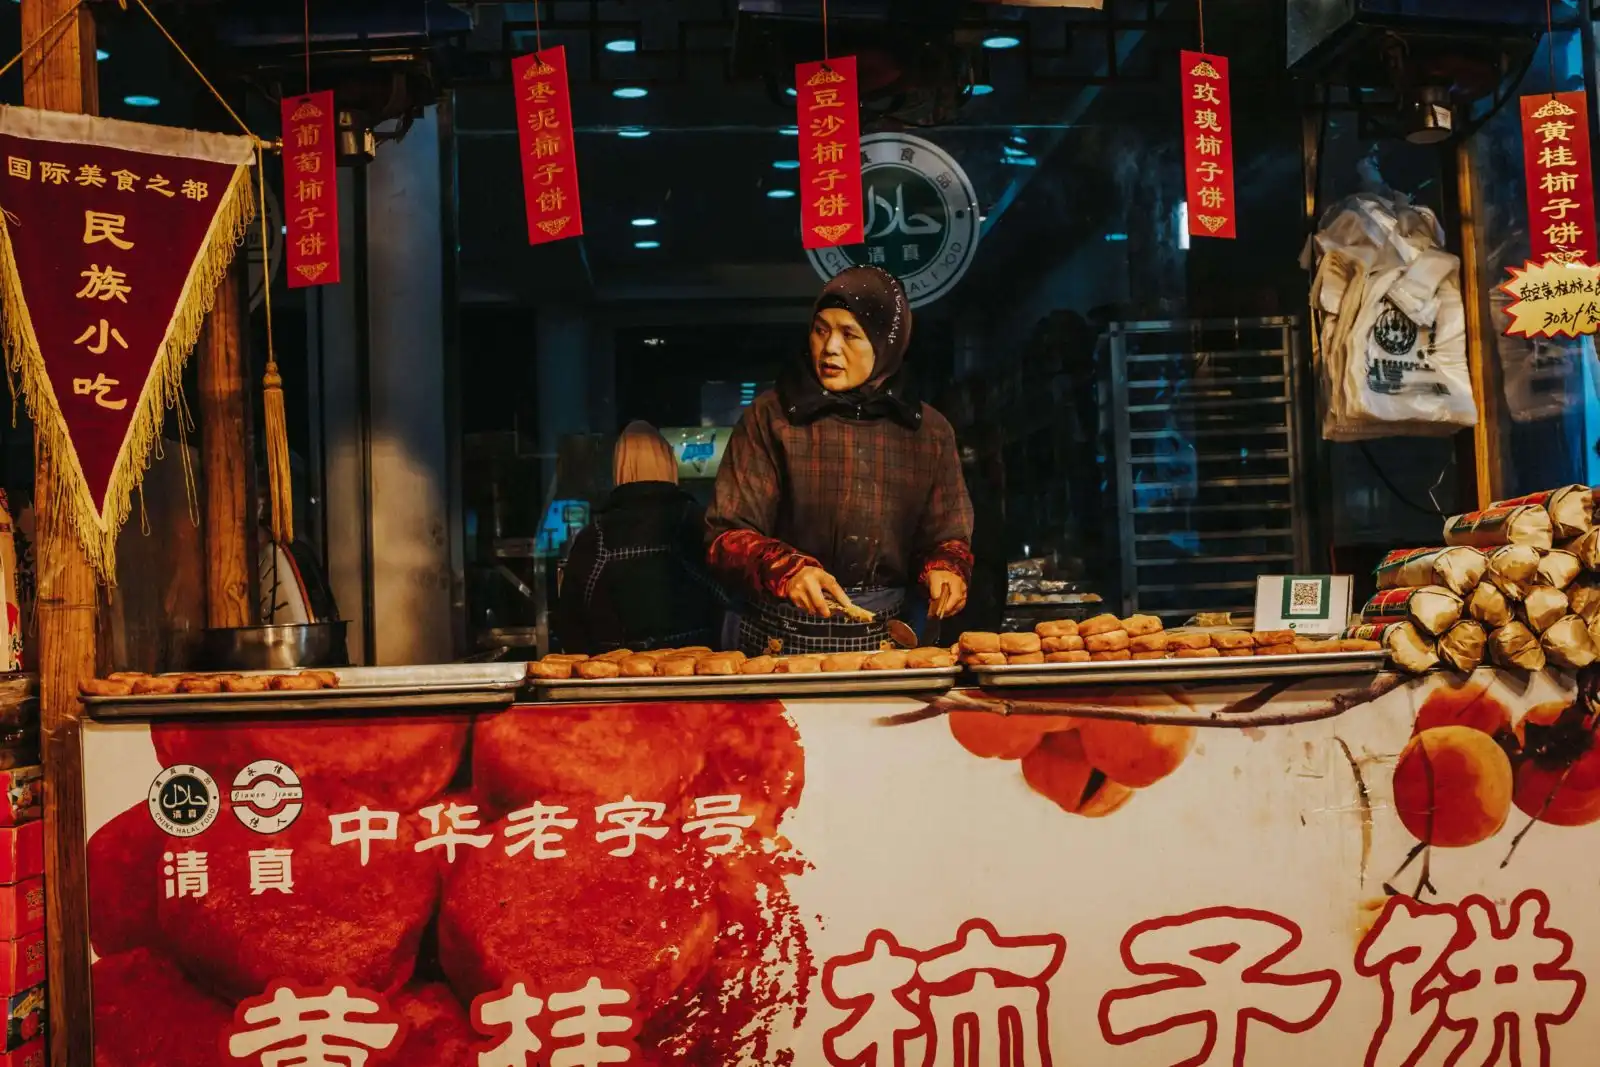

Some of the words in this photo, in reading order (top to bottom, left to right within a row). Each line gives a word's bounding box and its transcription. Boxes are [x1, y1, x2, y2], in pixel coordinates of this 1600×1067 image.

[7, 155, 210, 203] 国际美食之都
[290, 119, 328, 259] 葡萄柿子饼
[523, 77, 569, 212] 枣泥柿子饼
[808, 88, 850, 218] 豆沙柿子饼
[1192, 82, 1227, 210] 玫瑰柿子饼
[1534, 120, 1584, 246] 黄桂柿子饼
[72, 208, 136, 412] 民族小吃
[867, 243, 920, 263] 清真
[154, 812, 175, 832] CHINA
[176, 825, 201, 834] HALAL
[200, 807, 216, 828] FOOD
[163, 847, 296, 900] 清真
[328, 792, 757, 868] 中华老字号
[822, 888, 1587, 1067] 柿子饼
